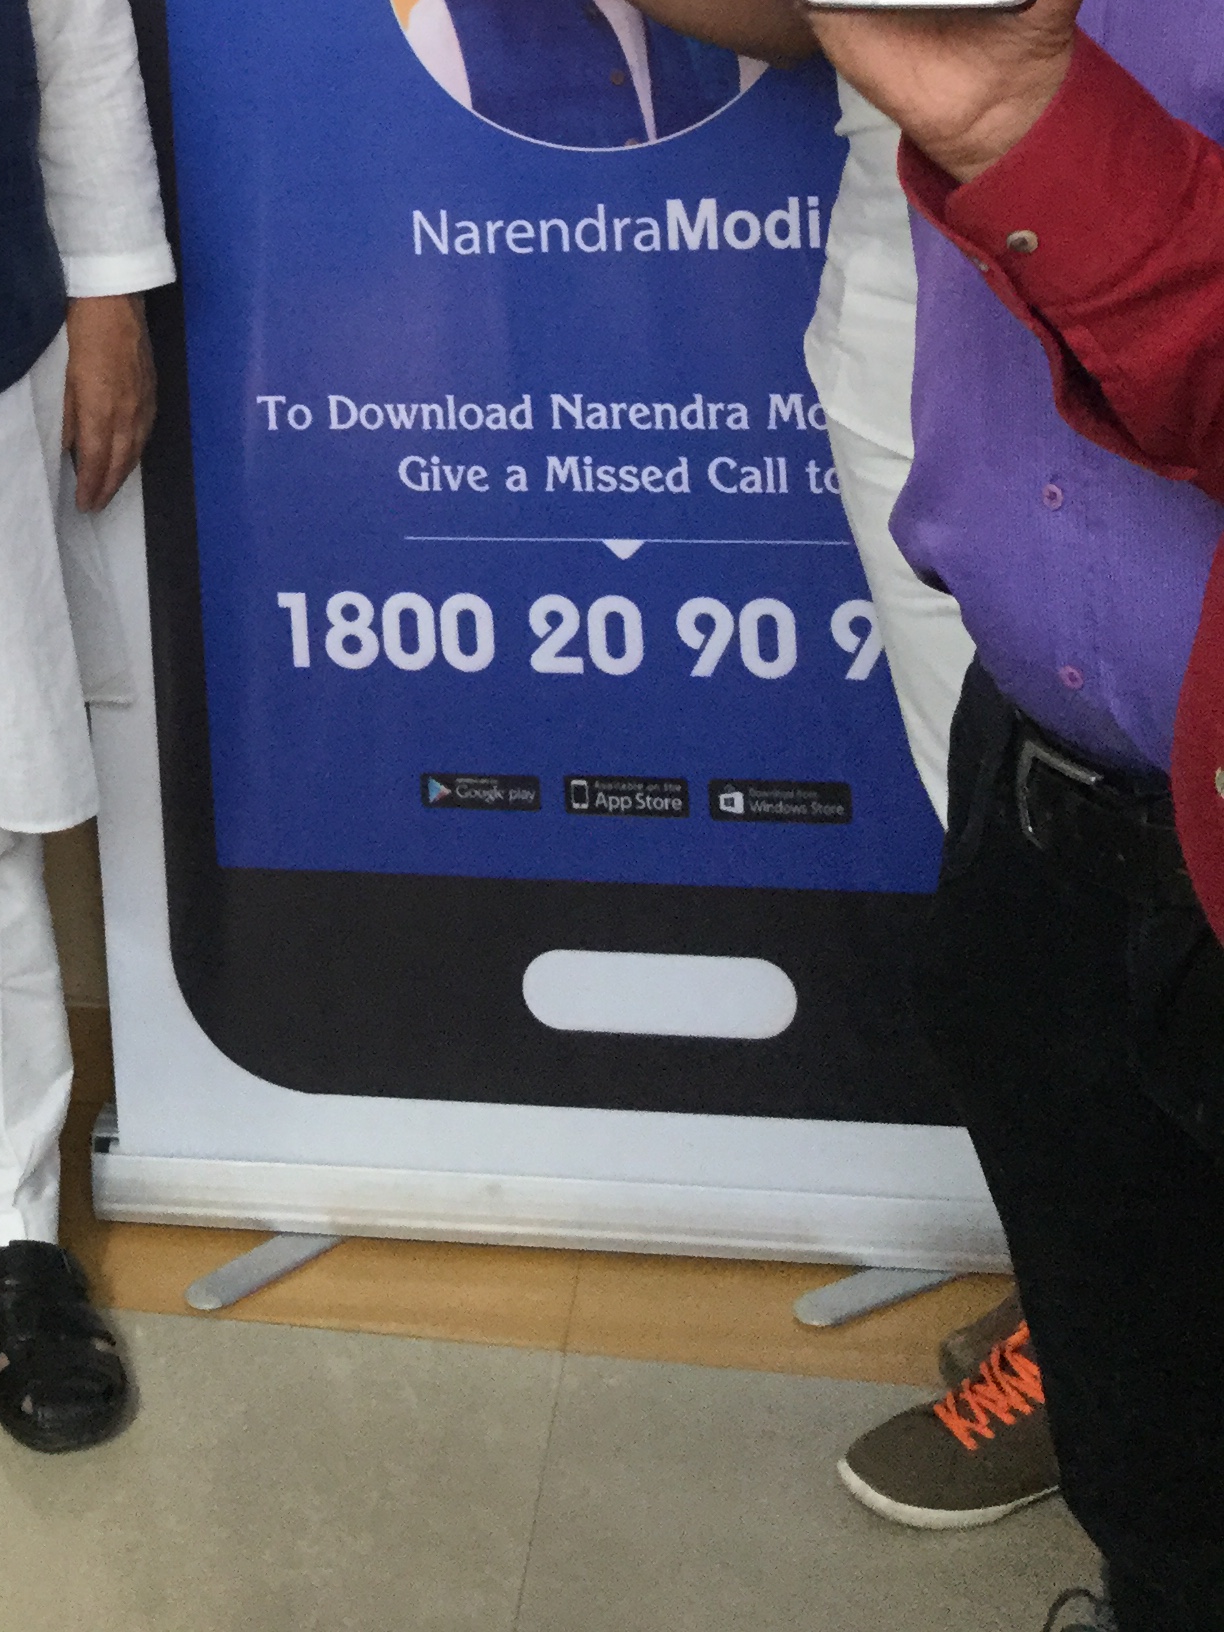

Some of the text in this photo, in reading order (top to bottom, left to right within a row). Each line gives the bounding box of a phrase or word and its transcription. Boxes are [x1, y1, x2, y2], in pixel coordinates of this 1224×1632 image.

[412, 195, 821, 256] NarendraModi
[256, 393, 828, 431] To Download Narendra Mo
[397, 454, 841, 495] Give a Missed Call to
[276, 590, 496, 673] 1800
[528, 593, 645, 676] 20
[675, 596, 798, 680] 90
[455, 784, 504, 803] Google
[595, 791, 683, 812] App Store
